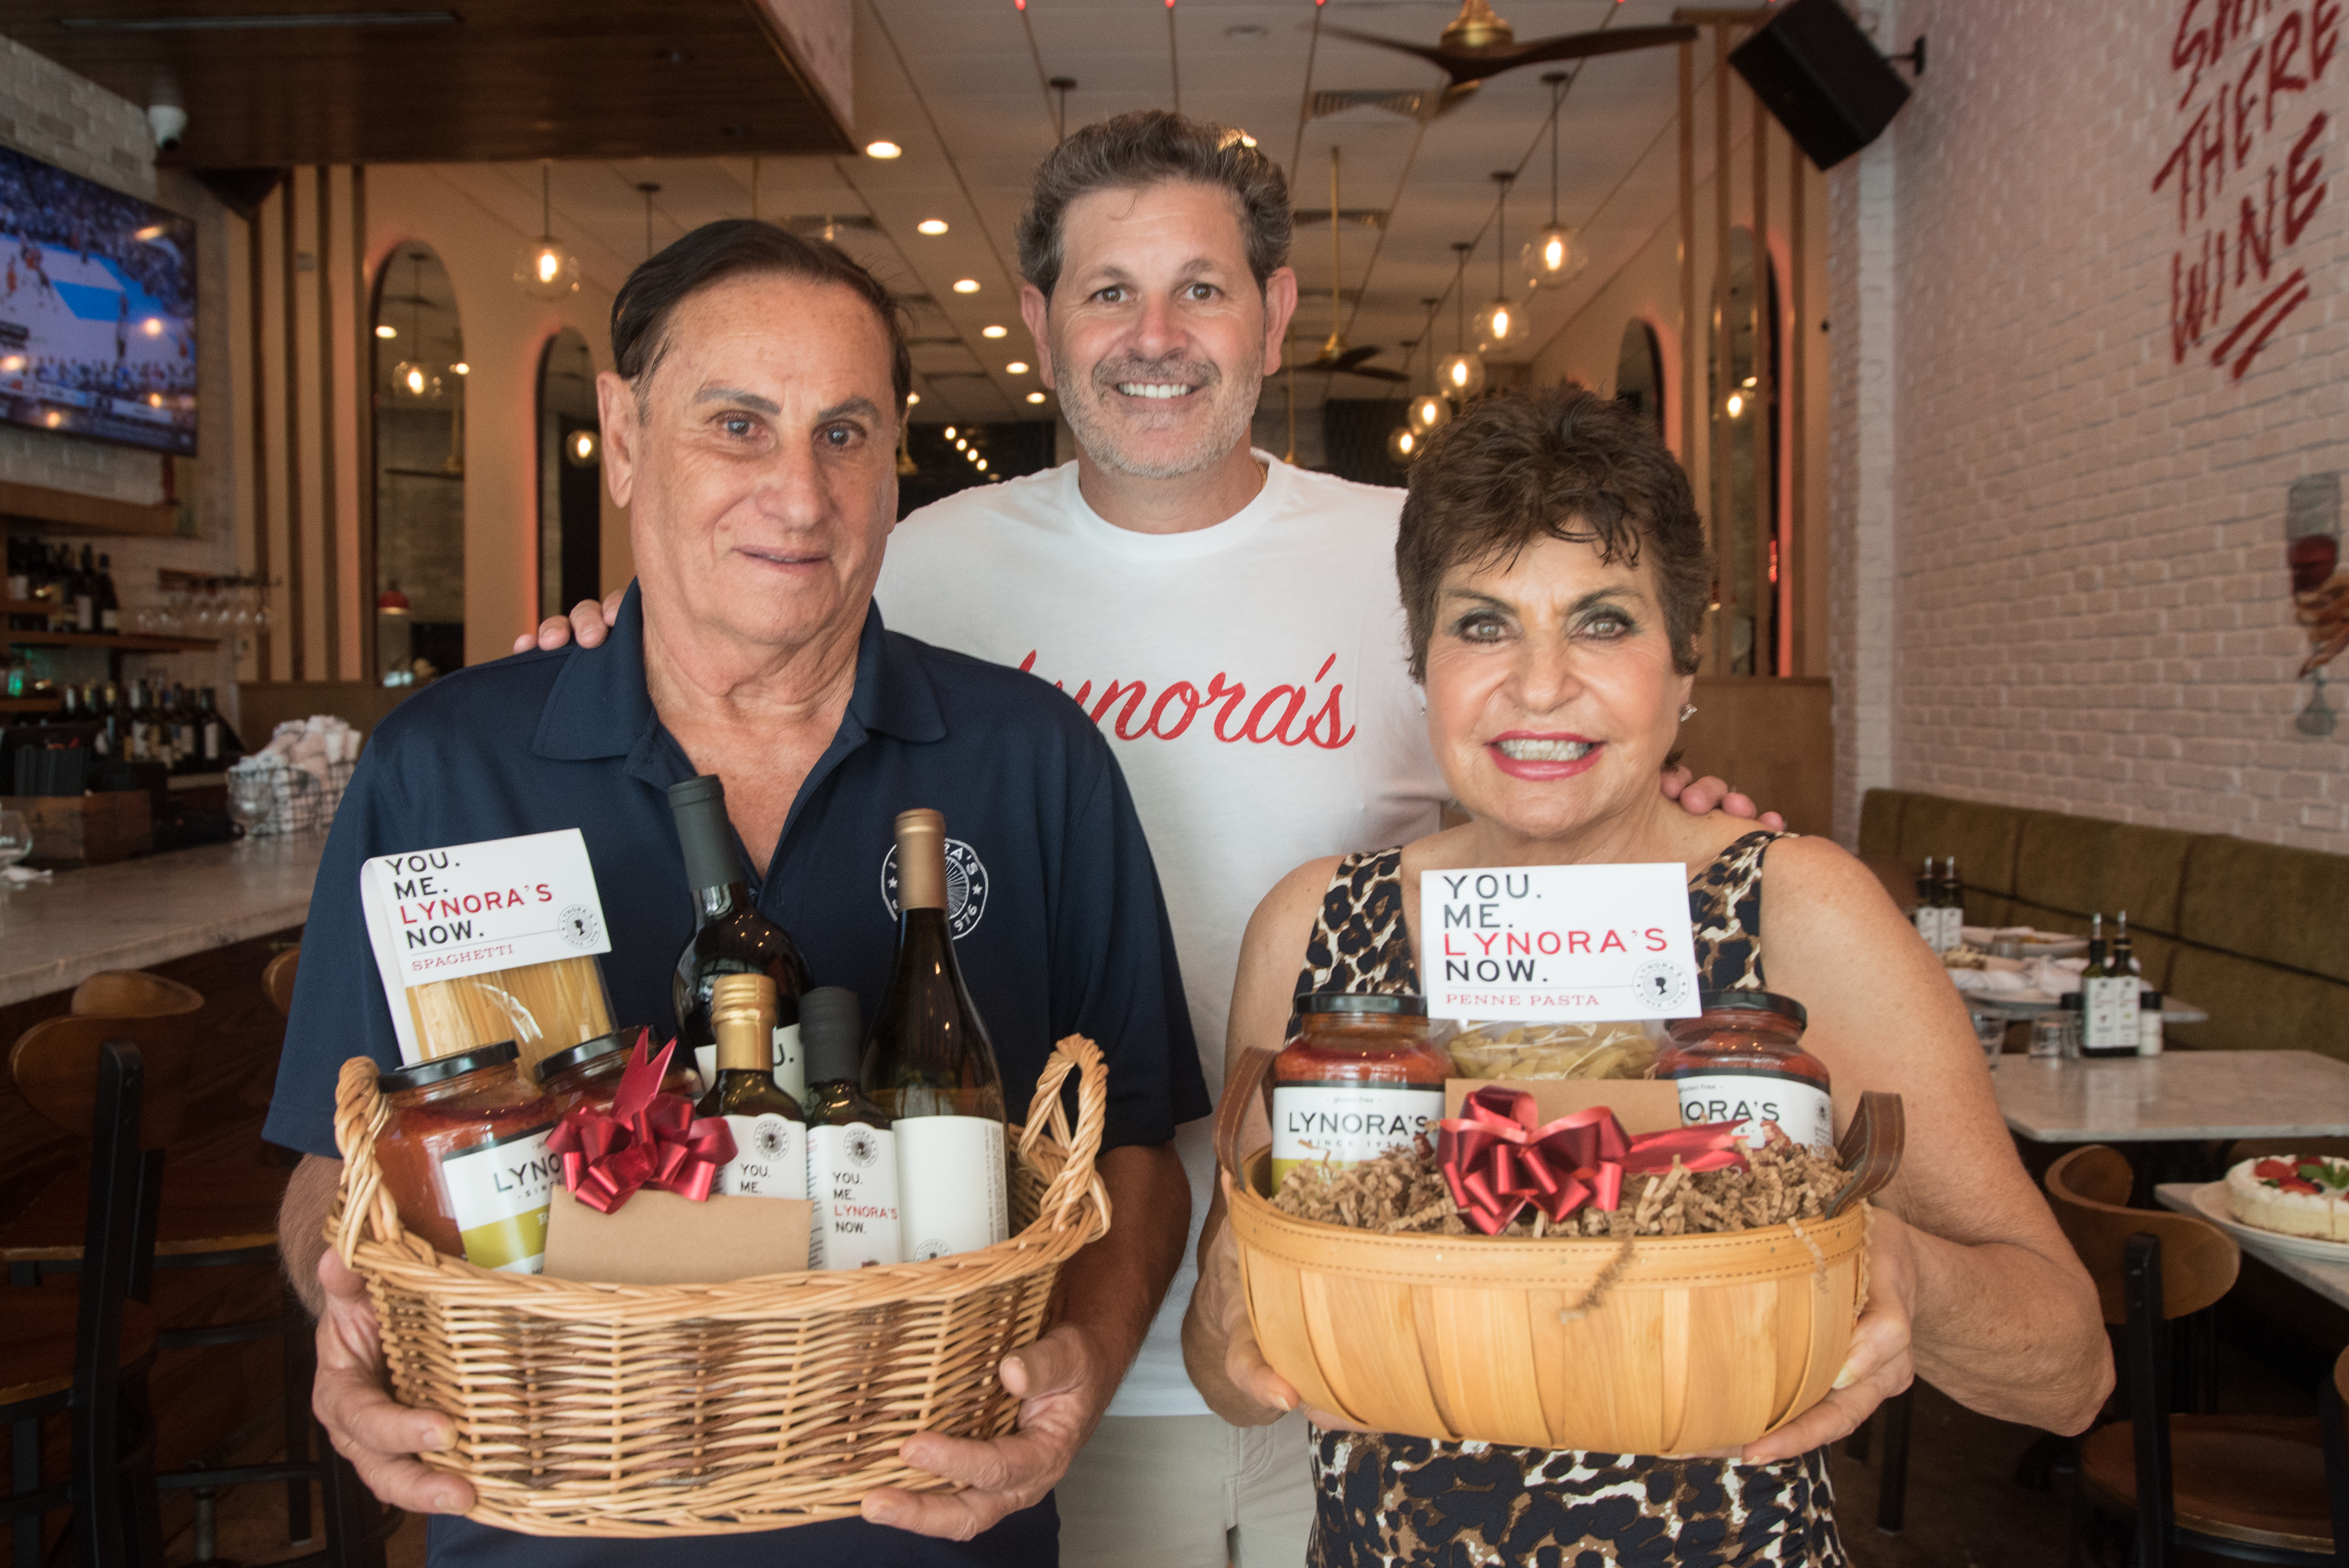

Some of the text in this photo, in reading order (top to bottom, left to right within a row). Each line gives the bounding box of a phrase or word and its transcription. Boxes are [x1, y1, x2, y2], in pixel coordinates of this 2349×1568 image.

[385, 851, 461, 876] YOU.
[394, 876, 449, 900] ME.
[1443, 874, 1542, 899] YOU.
[400, 884, 553, 924] LYNORA'S
[1445, 903, 1514, 928] ME.
[406, 919, 485, 949] NOW.
[1445, 928, 1668, 956] LYNORA'S
[412, 944, 514, 971] SPAGHETTI
[1446, 959, 1548, 983] NOW.
[1446, 994, 1600, 1006] PENNE PASTA
[1289, 1112, 1428, 1135] LYNORA'S
[494, 1152, 562, 1193] LYNO
[740, 1164, 771, 1178] YOU.
[832, 1172, 863, 1185] YOU.
[740, 1180, 762, 1194] ME.
[834, 1188, 856, 1201] ME.
[834, 1204, 898, 1220] LYNORA'S
[836, 1221, 867, 1234] NOW.
